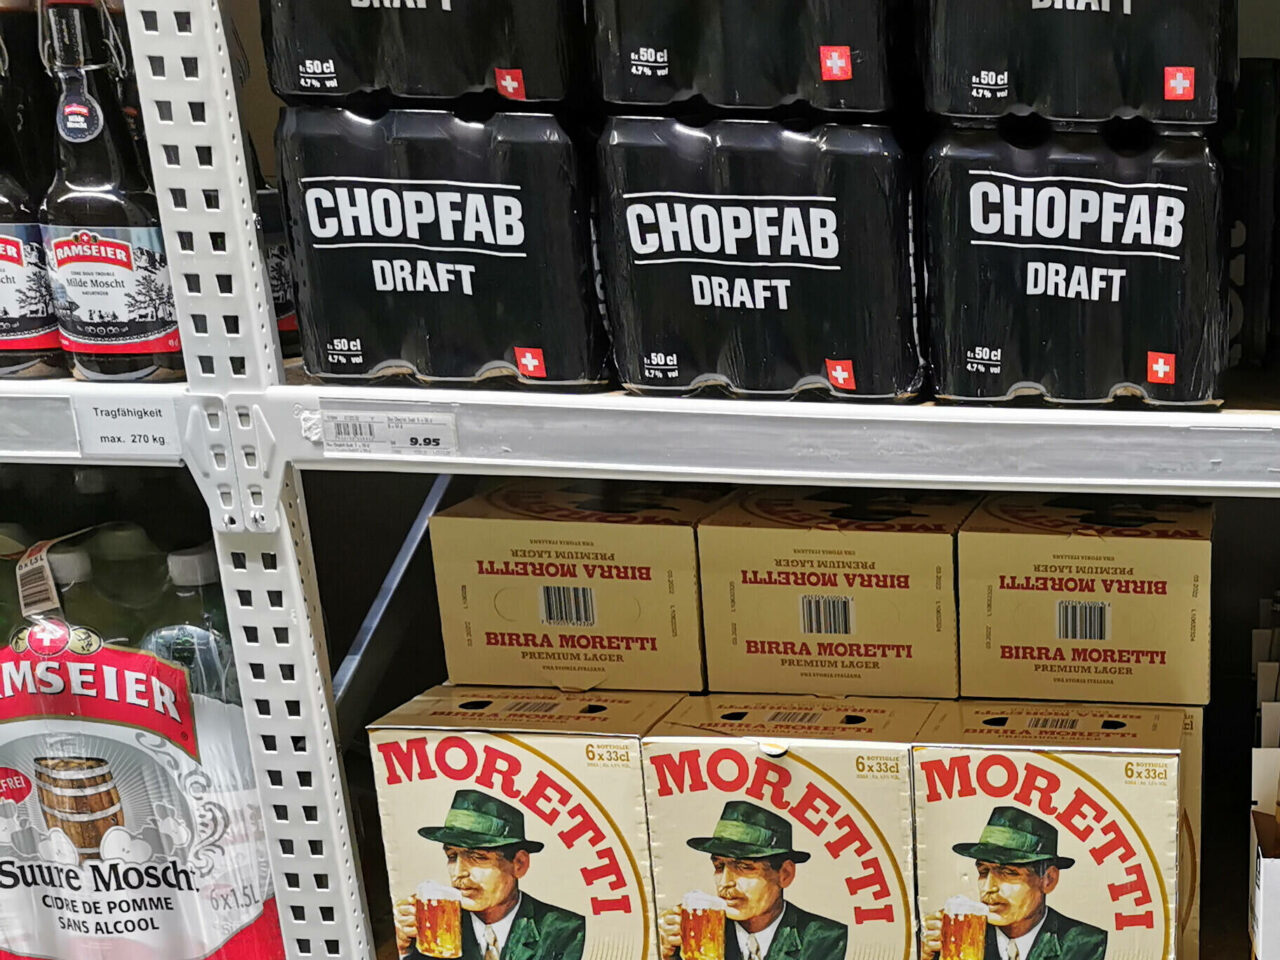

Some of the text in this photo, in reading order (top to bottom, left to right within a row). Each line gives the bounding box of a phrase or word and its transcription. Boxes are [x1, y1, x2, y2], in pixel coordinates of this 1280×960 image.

[640, 48, 668, 62] 50 cl
[305, 188, 526, 246] CHOPFAB
[969, 181, 1185, 248] CHOPFAB
[626, 202, 840, 259] CHOPFAB
[56, 243, 128, 262] RAMSEIER
[66, 277, 126, 289] Milde Moscht
[372, 259, 475, 296] DRAFT
[1026, 262, 1126, 302] DRAFT
[692, 274, 790, 310] DRAFT
[93, 407, 162, 419] Tragfähigkeit
[131, 434, 149, 443] 270
[152, 435, 165, 445] kg
[409, 436, 441, 446] 9.95
[485, 631, 657, 651] BIRRA MORETTI
[521, 651, 624, 663] PREMIUM LAGER
[1124, 761, 1168, 779] 6 x 33cl
[377, 735, 632, 916] MORETTI
[650, 747, 895, 926] MORETTI
[920, 754, 1154, 931] MORETTI
[0, 860, 82, 891] Suure
[42, 894, 174, 914] CIDRE DE POMME
[58, 916, 160, 934] SANS ALCOOL
